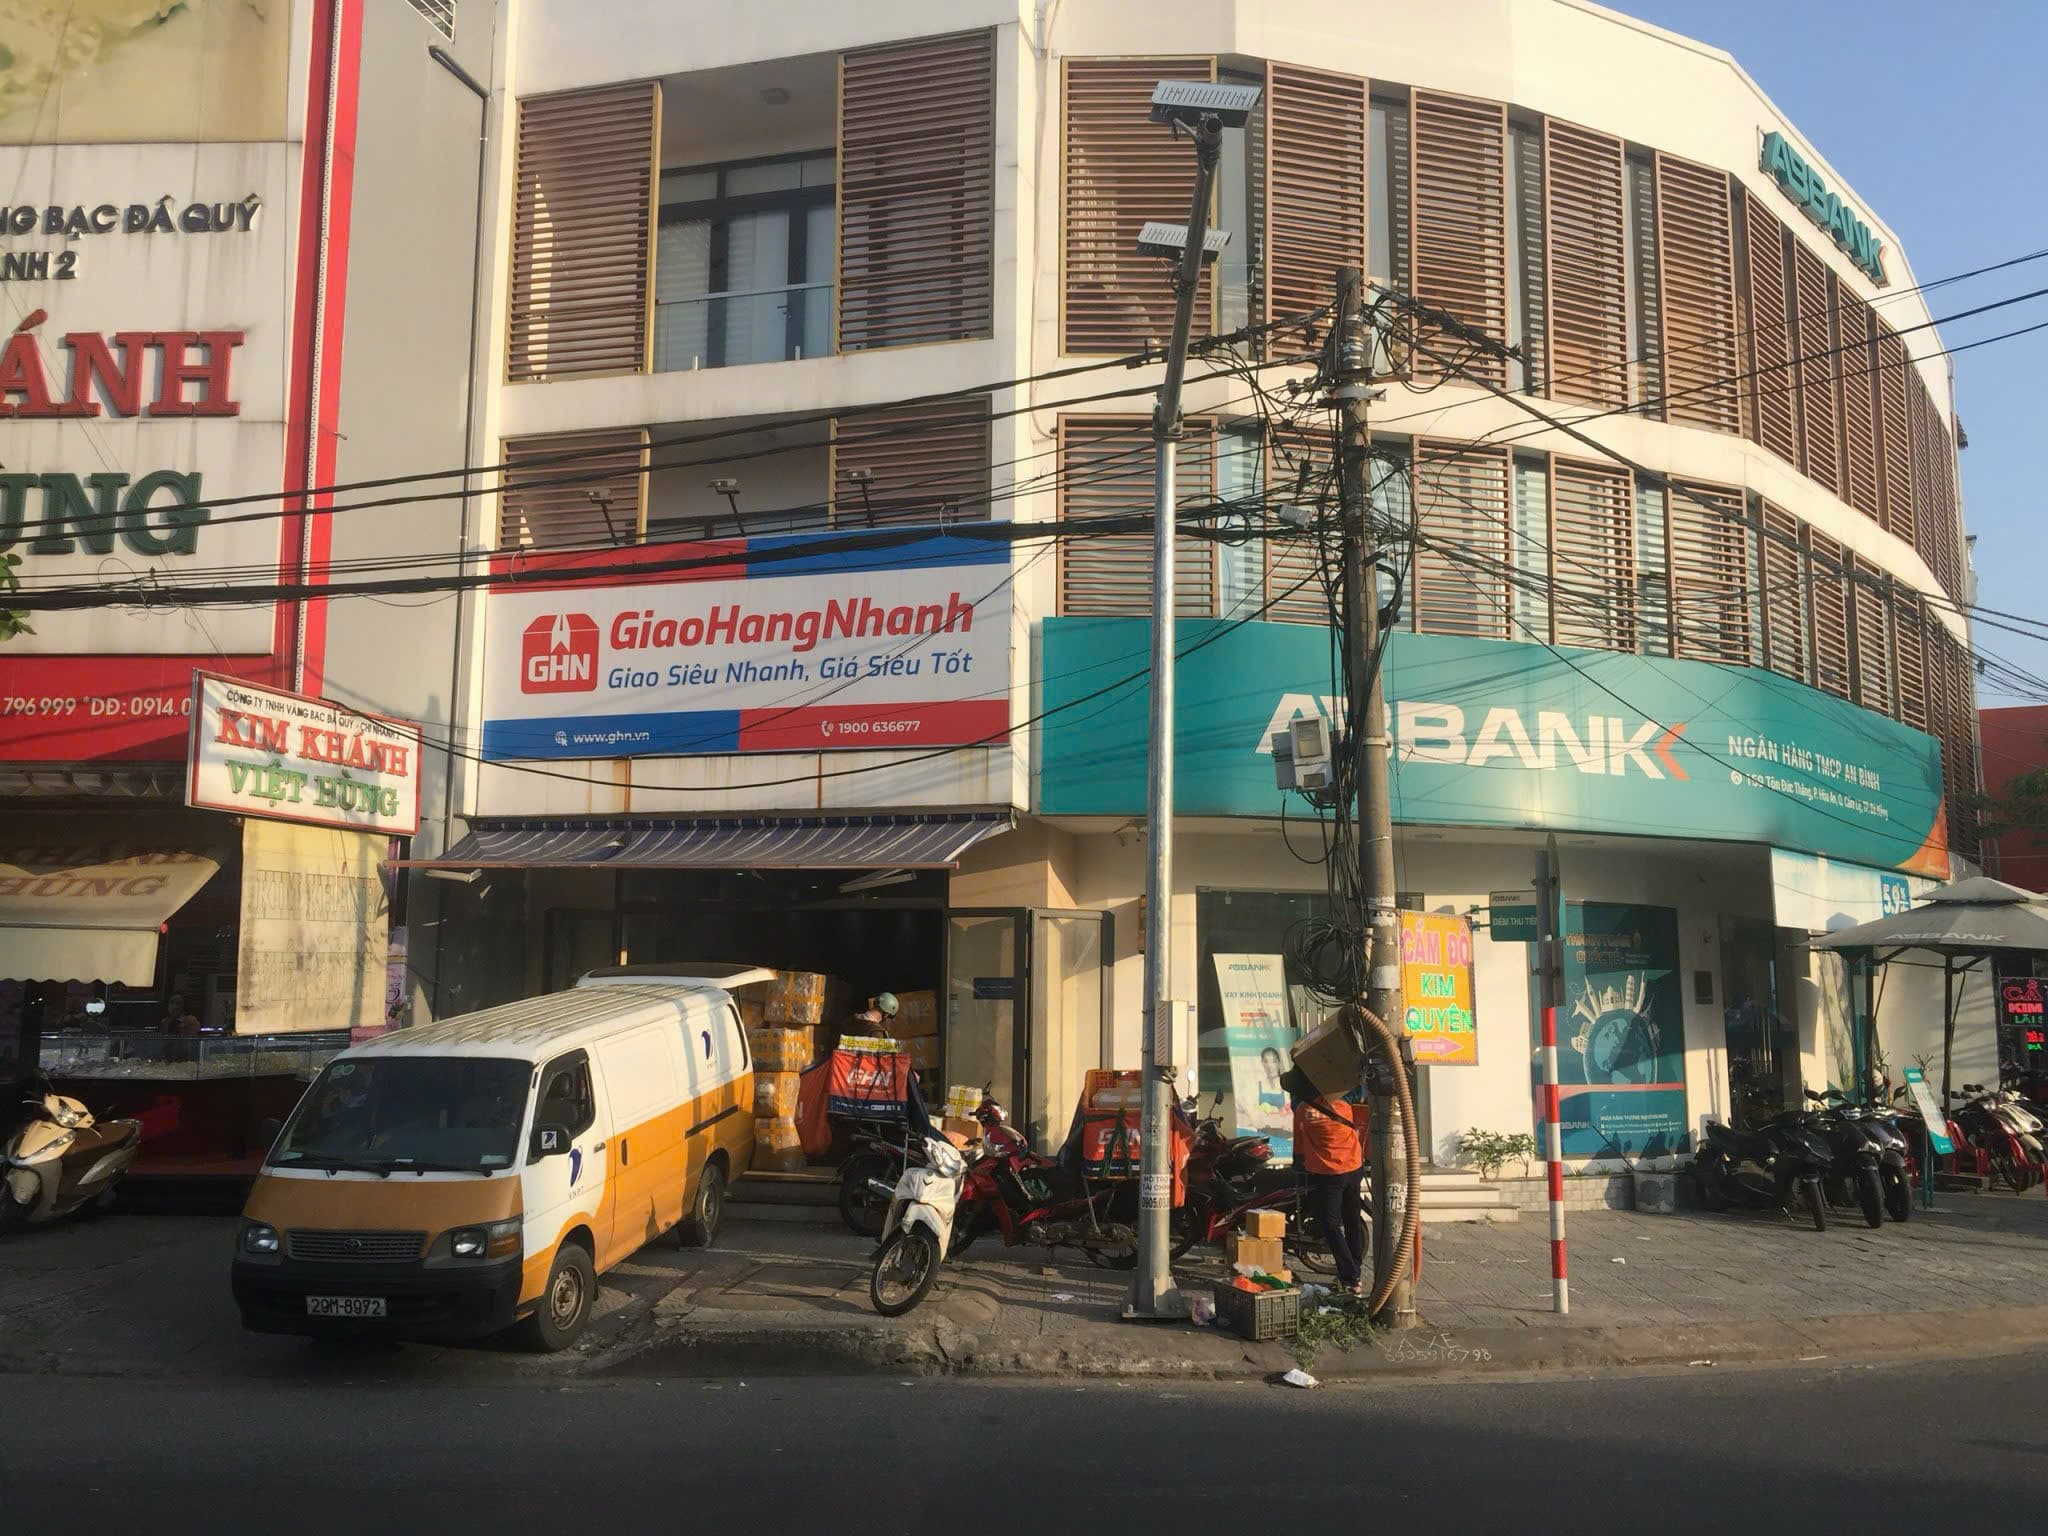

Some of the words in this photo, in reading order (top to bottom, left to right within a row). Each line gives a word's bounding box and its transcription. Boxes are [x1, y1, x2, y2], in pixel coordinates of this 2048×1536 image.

[45, 203, 119, 240] BẠC
[126, 194, 175, 233] ĐÁ
[181, 193, 262, 232] QUÝ
[1761, 131, 1887, 288] ABBANK
[55, 250, 80, 281] 2
[610, 592, 975, 652] GiaoHangNhanh
[528, 653, 590, 683] GHN
[607, 667, 660, 690] Giao
[667, 661, 718, 687] Siêu
[726, 658, 811, 687] Nhanh,
[819, 653, 859, 679] Giá
[866, 650, 921, 677] Siêu
[931, 647, 974, 675] Tốt
[40, 697, 77, 716] 999
[253, 695, 264, 708] TY
[265, 698, 285, 713] TNHH
[573, 729, 651, 746] www.ghn.vn
[838, 720, 869, 734] 1900
[871, 718, 921, 734] 636677
[215, 707, 290, 754] KIM
[297, 725, 409, 777] KHÁNH
[1728, 733, 1779, 763] NGÂN
[1782, 741, 1813, 772] HÀNG
[1815, 753, 1842, 780] TMCP
[225, 757, 309, 808] VIỆT
[313, 769, 400, 817] HÙNG
[1420, 972, 1456, 998] KIM
[846, 1068, 893, 1088] GHN
[311, 1298, 381, 1315] 29M-8972
